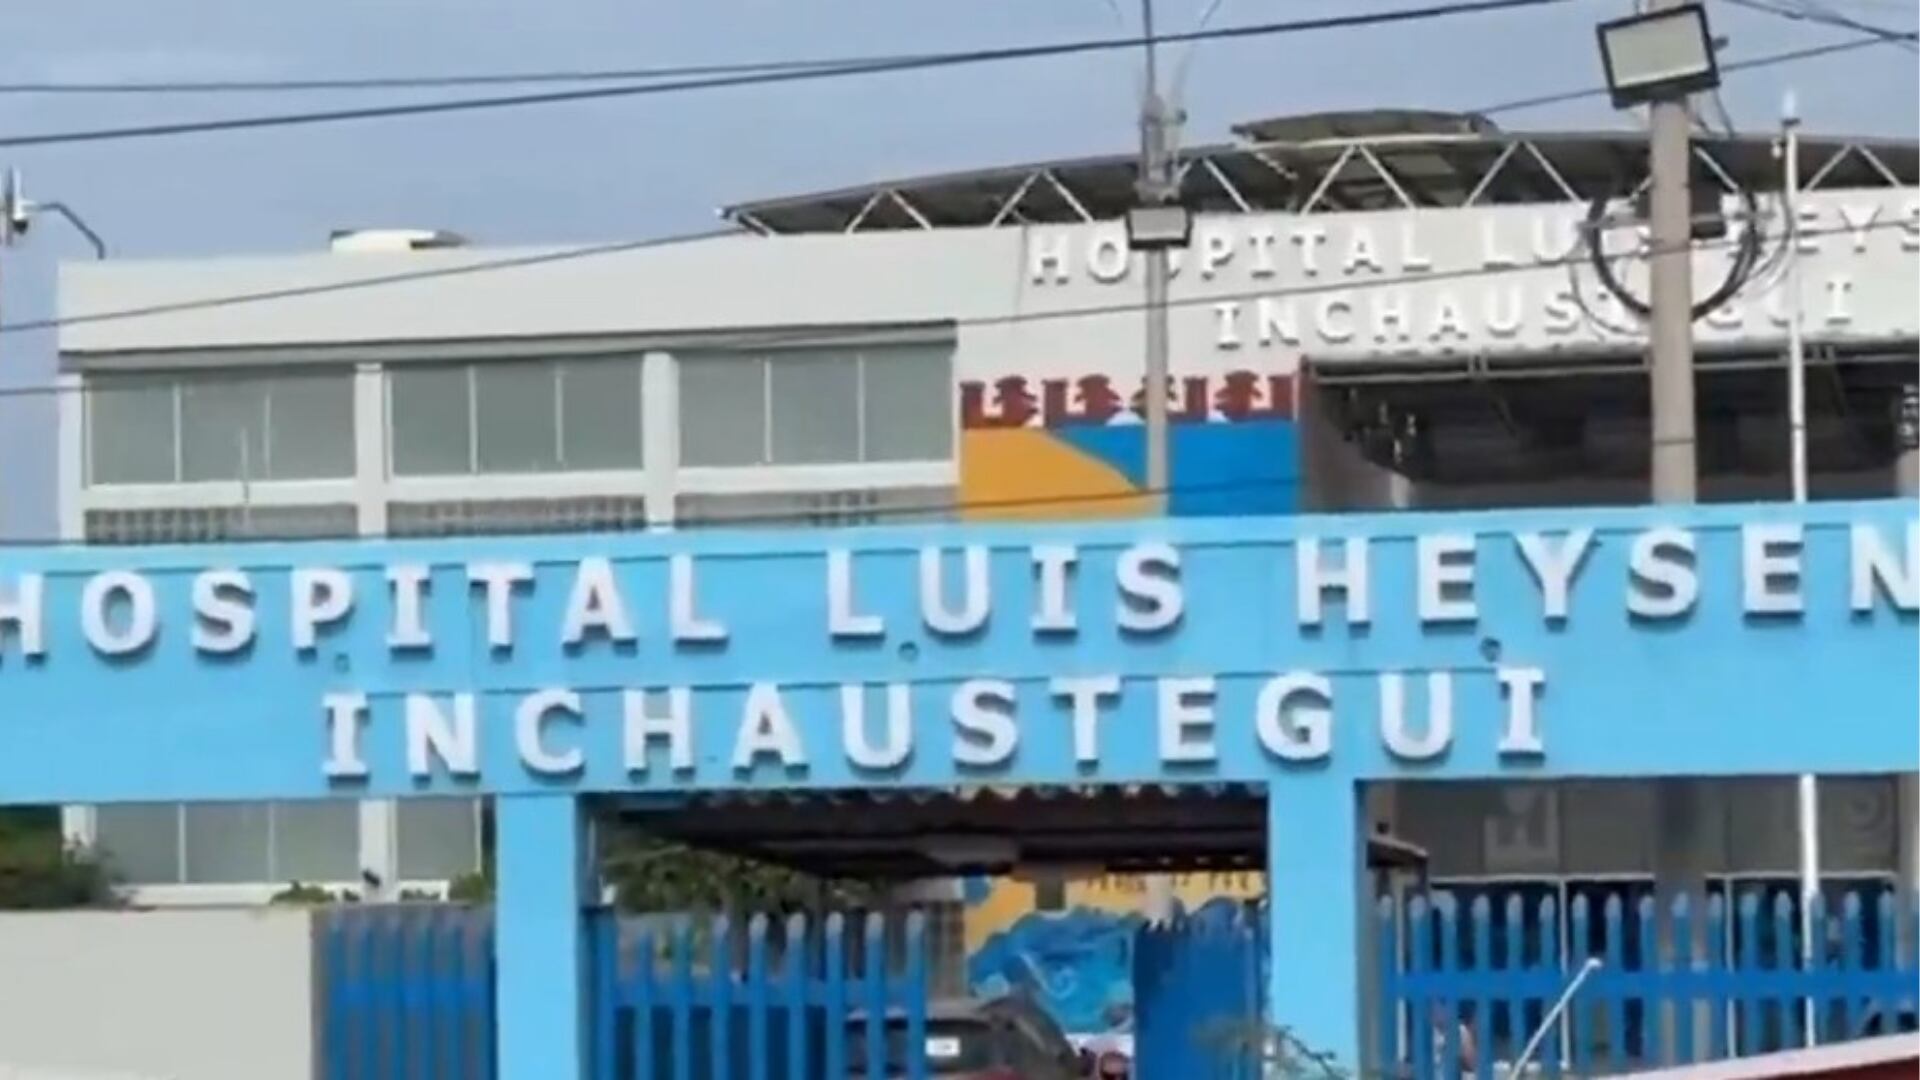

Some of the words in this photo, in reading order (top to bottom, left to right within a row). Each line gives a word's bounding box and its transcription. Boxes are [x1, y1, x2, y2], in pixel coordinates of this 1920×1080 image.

[1030, 217, 1432, 281] HOPITAL
[0, 555, 728, 656] HOSPITAL
[826, 543, 1186, 637] LUIS
[1295, 520, 1919, 627] HEYSEN
[322, 667, 1547, 777] INCHAUSTEGUI
